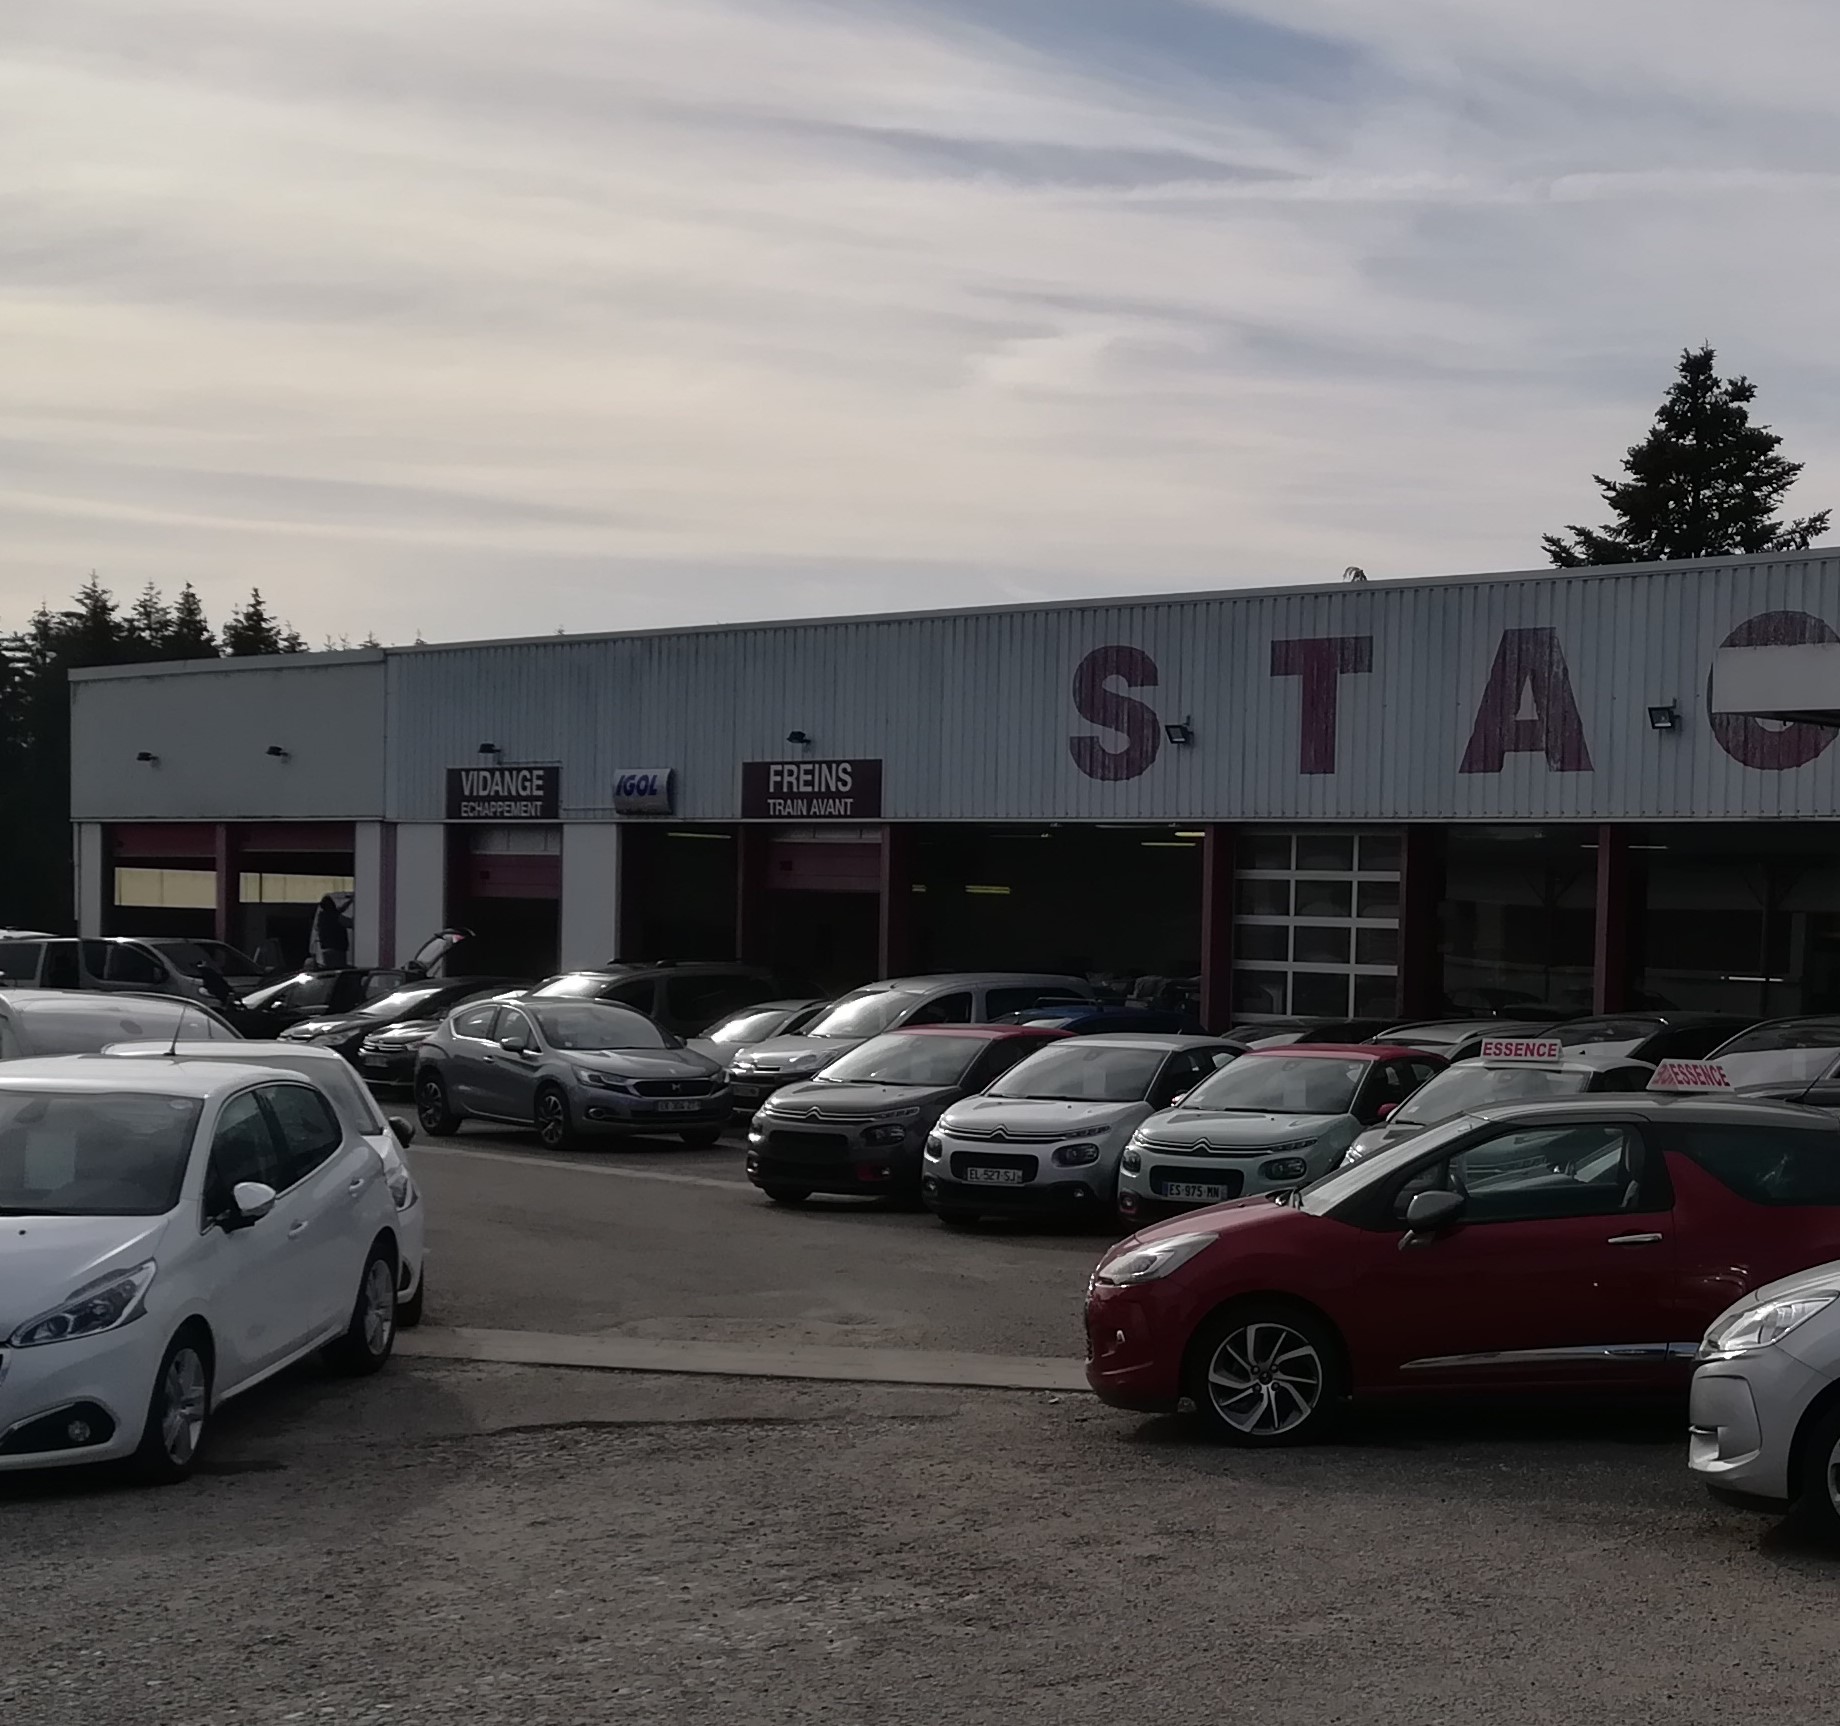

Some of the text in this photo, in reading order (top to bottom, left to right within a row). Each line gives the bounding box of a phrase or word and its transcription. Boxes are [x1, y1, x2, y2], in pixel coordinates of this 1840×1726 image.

[461, 769, 545, 797] VIDANGE
[615, 774, 658, 796] IGOL
[769, 762, 853, 793] FREINS
[461, 801, 542, 817] ECHAPPEMENT
[767, 798, 854, 816] TRAIN AVANT
[1483, 1042, 1558, 1057] ESSENCE
[1668, 1063, 1731, 1087] ESSENCE
